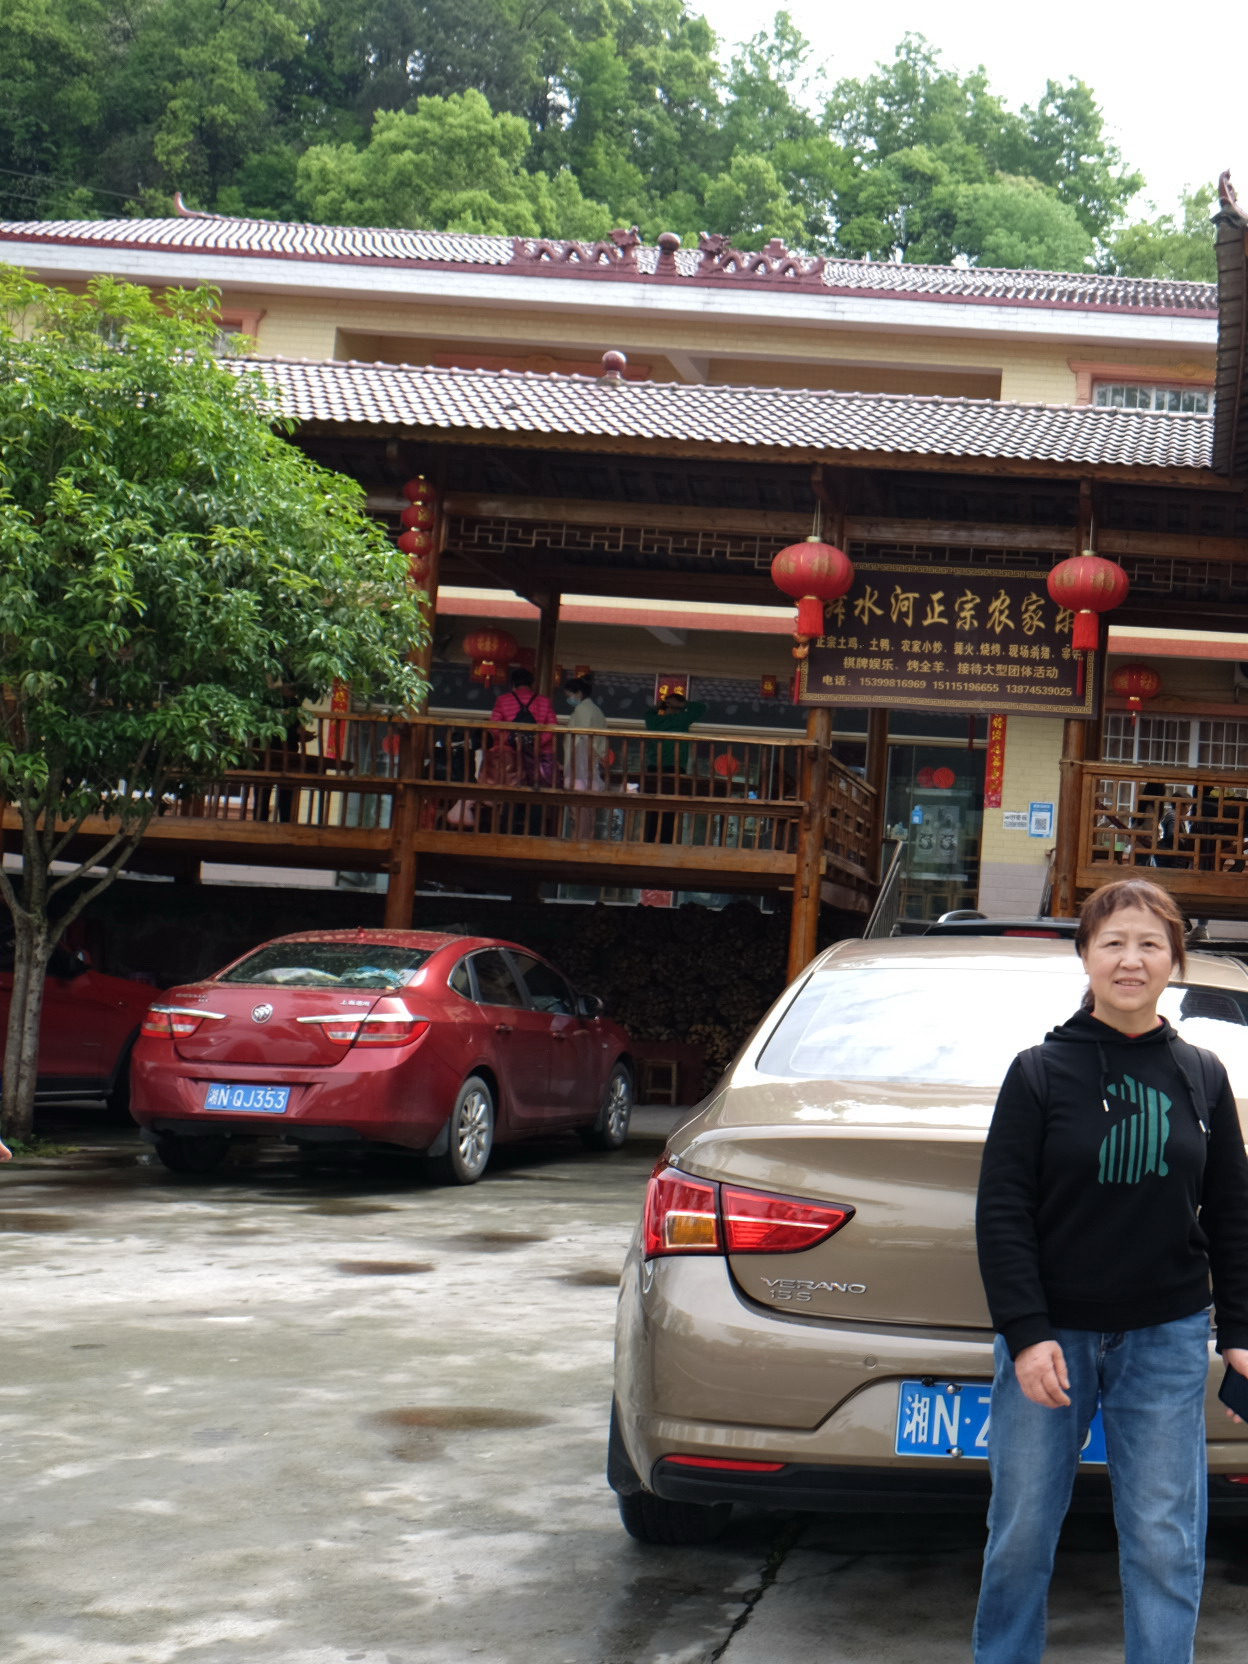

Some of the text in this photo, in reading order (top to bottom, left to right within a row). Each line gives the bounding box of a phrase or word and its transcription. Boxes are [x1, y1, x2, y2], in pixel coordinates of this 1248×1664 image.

[859, 677, 926, 689] 15399816969
[932, 680, 999, 693] 15115196655
[1005, 683, 1072, 697] 13874539025
[760, 1276, 867, 1294] VERANO
